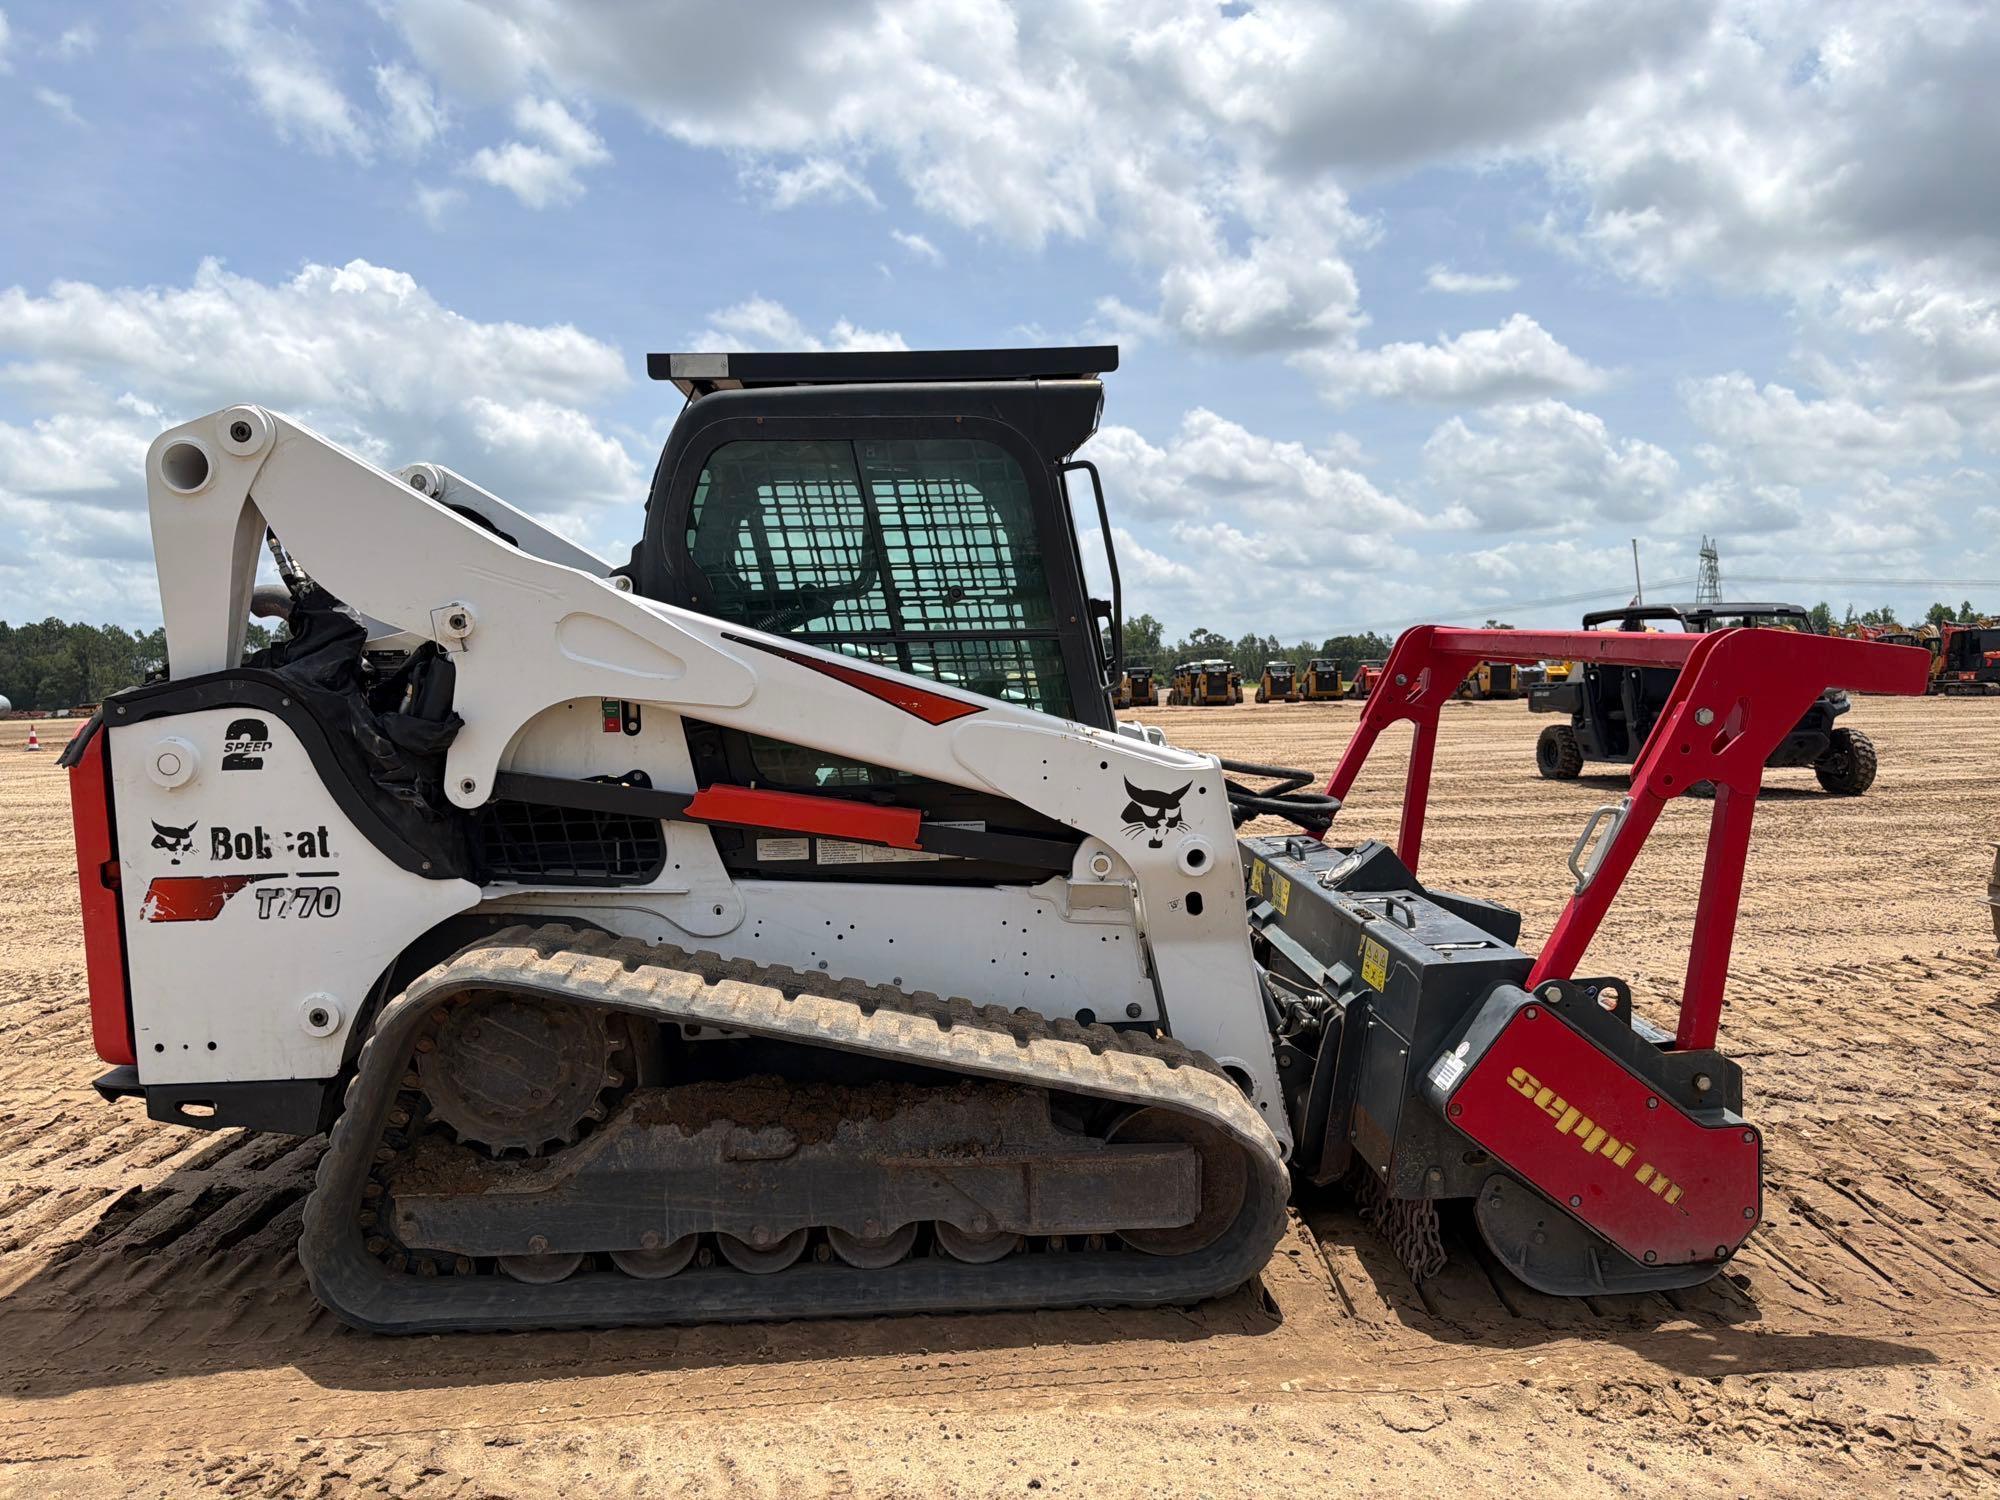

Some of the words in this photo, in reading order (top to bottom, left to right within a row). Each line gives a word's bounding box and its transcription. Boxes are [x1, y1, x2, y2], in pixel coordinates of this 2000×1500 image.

[221, 718, 269, 771] 2
[223, 741, 273, 753] SPEED
[1506, 1066, 1638, 1169] seppi
